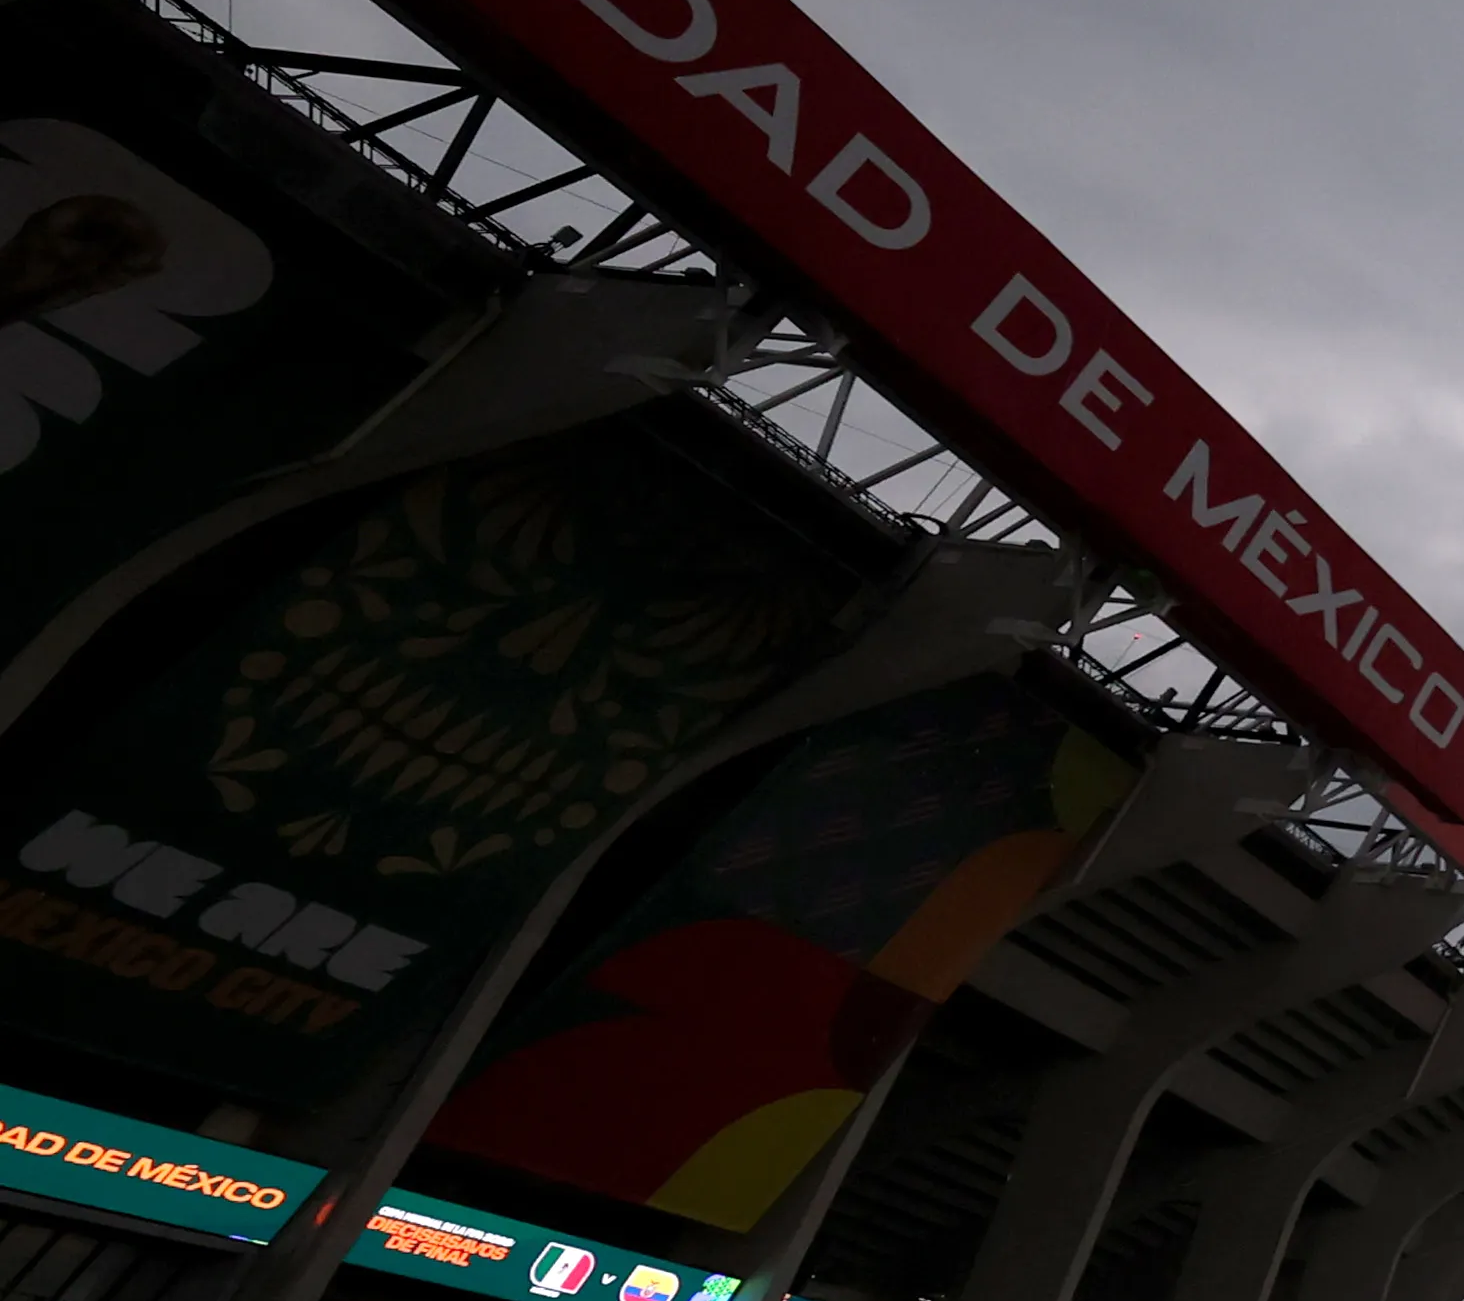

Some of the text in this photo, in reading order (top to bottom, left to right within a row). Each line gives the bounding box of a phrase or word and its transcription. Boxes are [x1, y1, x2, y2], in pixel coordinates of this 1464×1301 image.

[971, 272, 1153, 449] DE
[19, 808, 430, 993] WE ARE
[206, 967, 362, 1033] CITY
[64, 1141, 131, 1173] DE
[127, 1157, 287, 1210] MÉXICO
[366, 1215, 511, 1261] DIECISEISAVOS
[385, 1235, 471, 1267] DE FINAL
